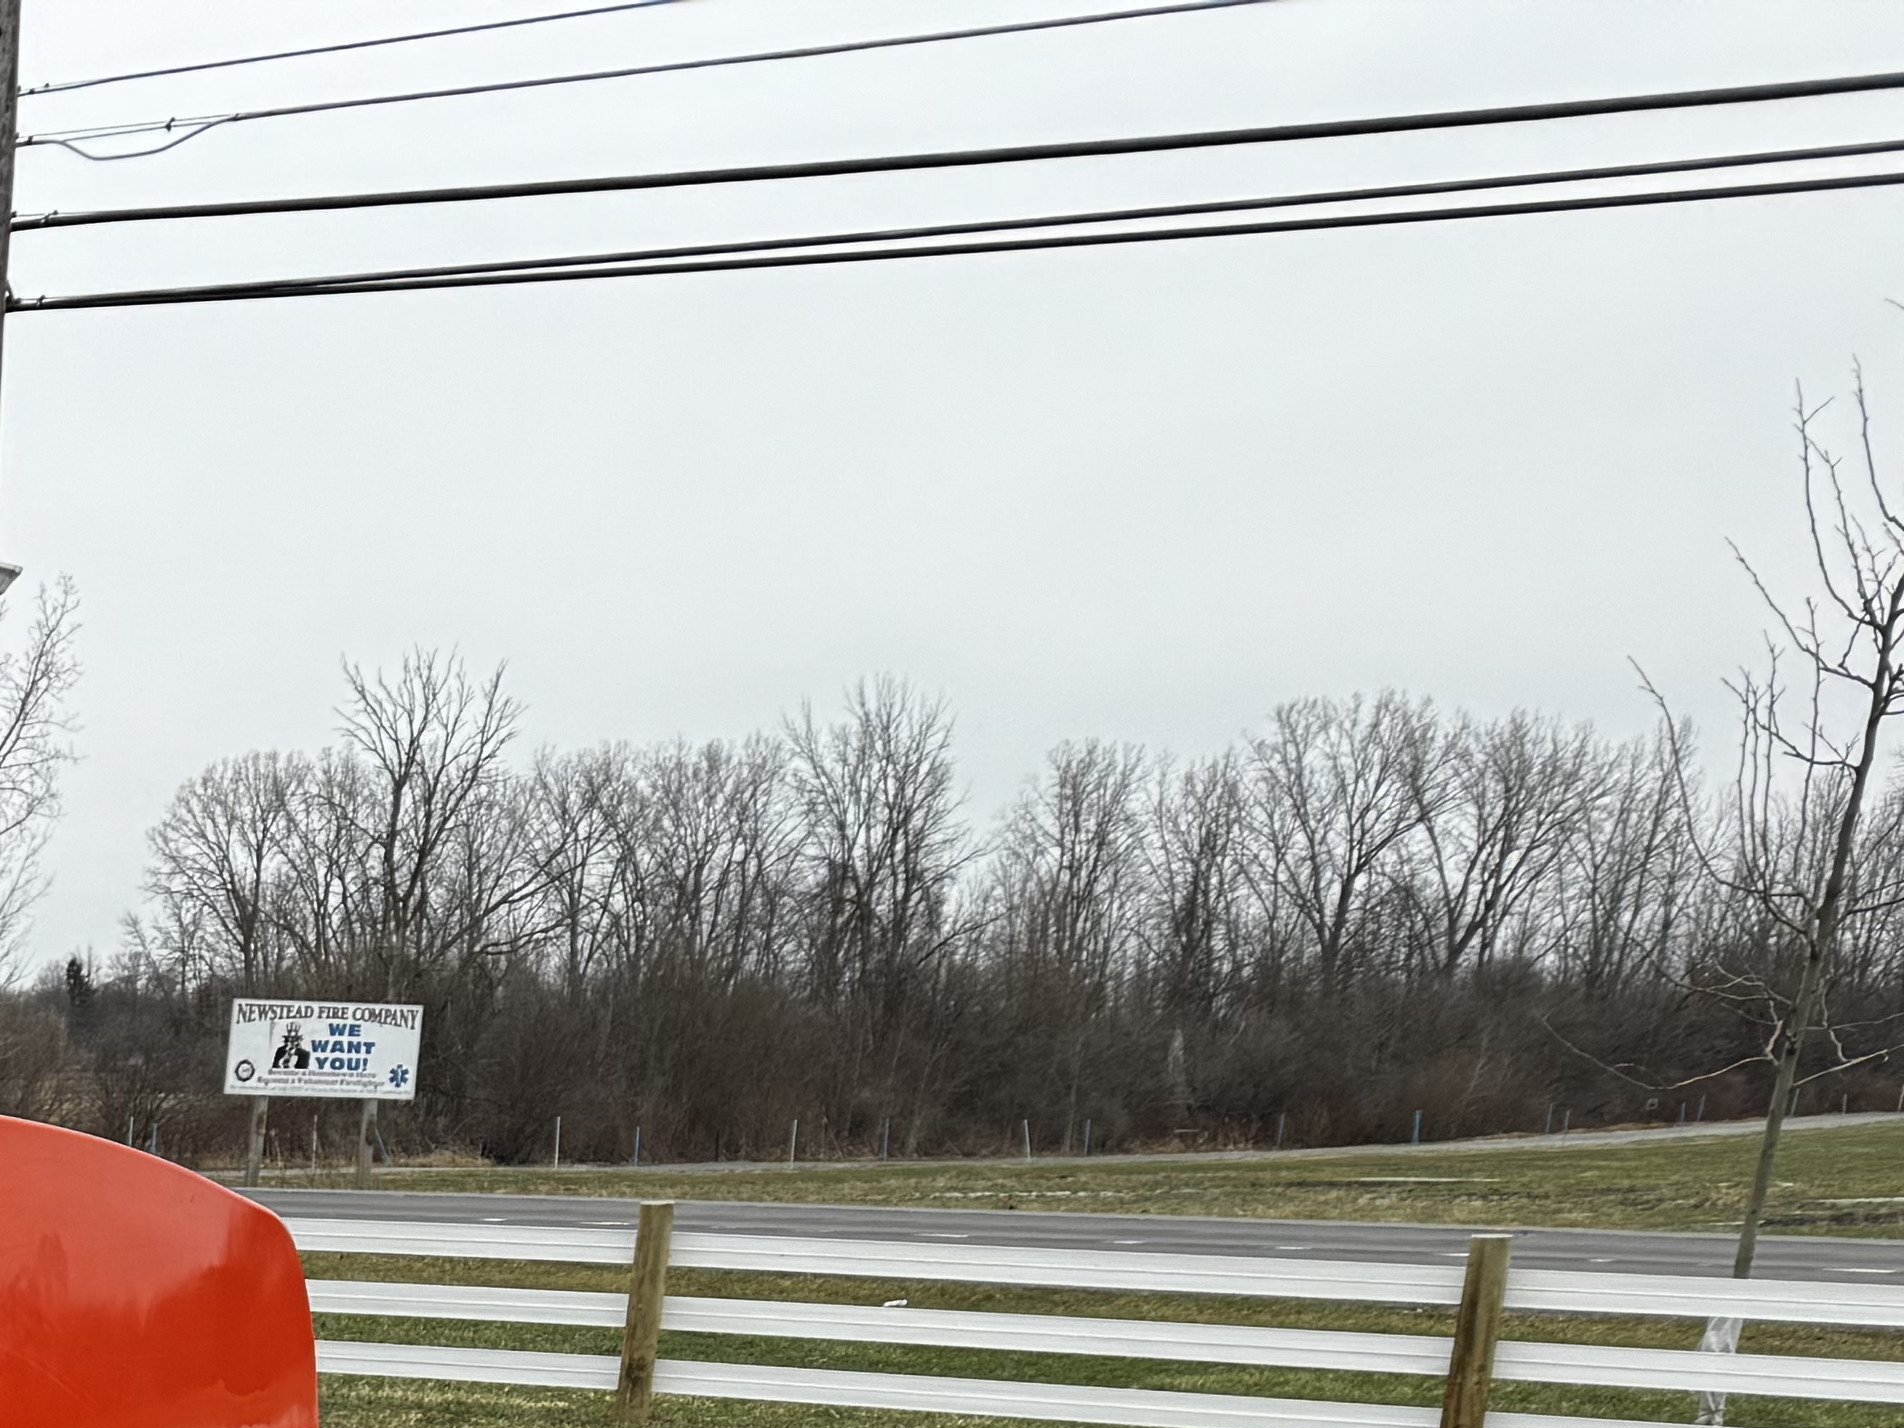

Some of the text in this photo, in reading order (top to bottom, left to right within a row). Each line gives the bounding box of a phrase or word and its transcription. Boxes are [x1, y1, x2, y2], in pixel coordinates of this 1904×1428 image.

[236, 1003, 420, 1030] NEWSTEAD FIRE COMPANY
[328, 1022, 362, 1037] WE
[311, 1039, 376, 1055] WANT
[315, 1056, 369, 1072] YOU!
